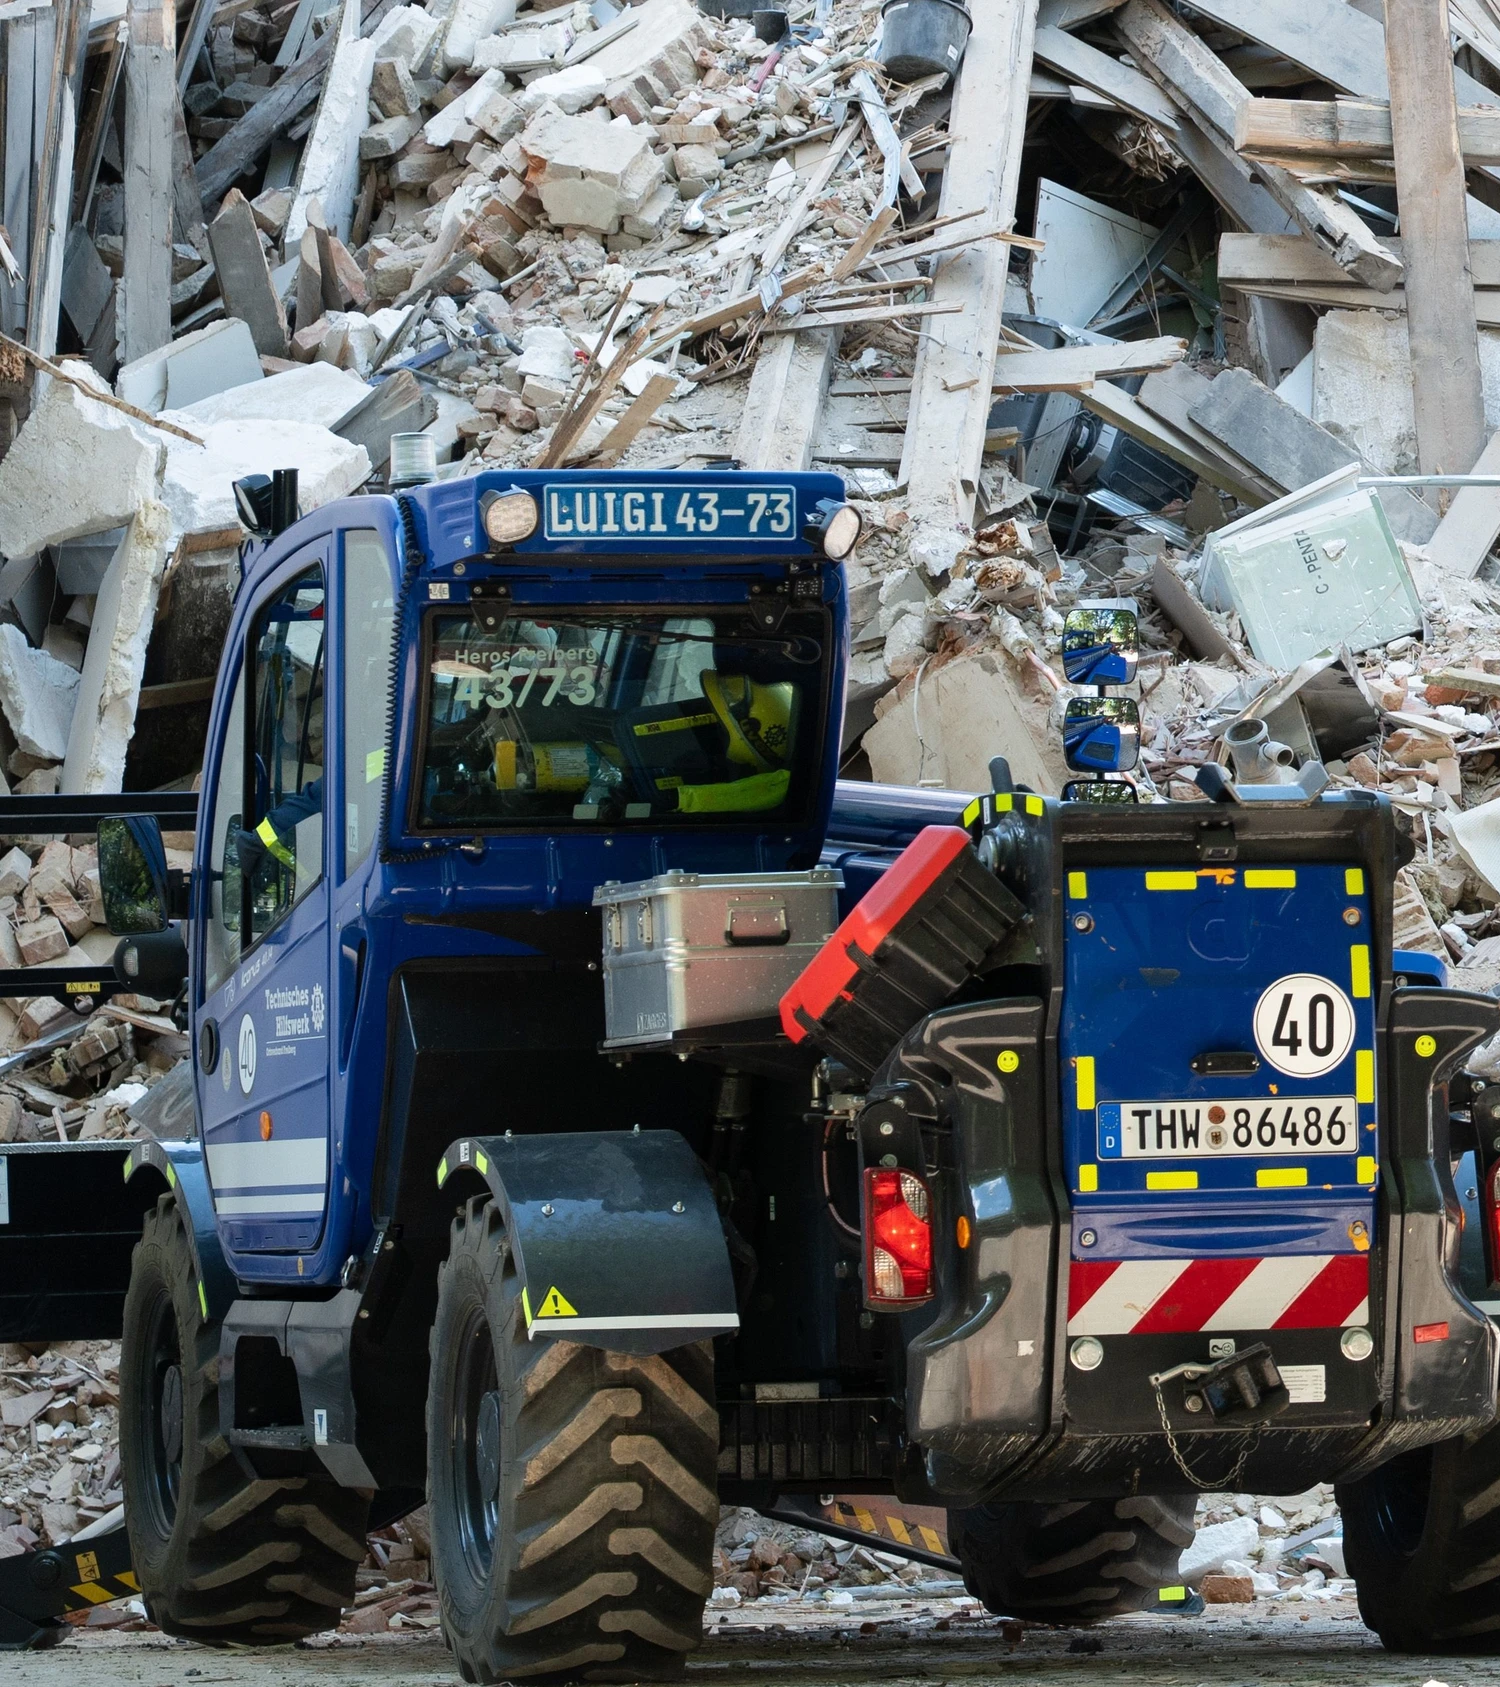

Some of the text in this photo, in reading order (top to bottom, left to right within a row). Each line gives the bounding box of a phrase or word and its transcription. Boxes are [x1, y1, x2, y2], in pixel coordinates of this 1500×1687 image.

[551, 492, 791, 533] LUIGI 43-73
[455, 649, 511, 664] Heros
[454, 666, 596, 710] 43/73
[265, 985, 309, 1010] Technisches
[275, 1012, 310, 1037] Hilfswerk
[1271, 993, 1334, 1057] 40
[240, 1029, 254, 1079] 40
[1105, 1135, 1115, 1149] D
[1131, 1105, 1346, 1150] THW 86486
